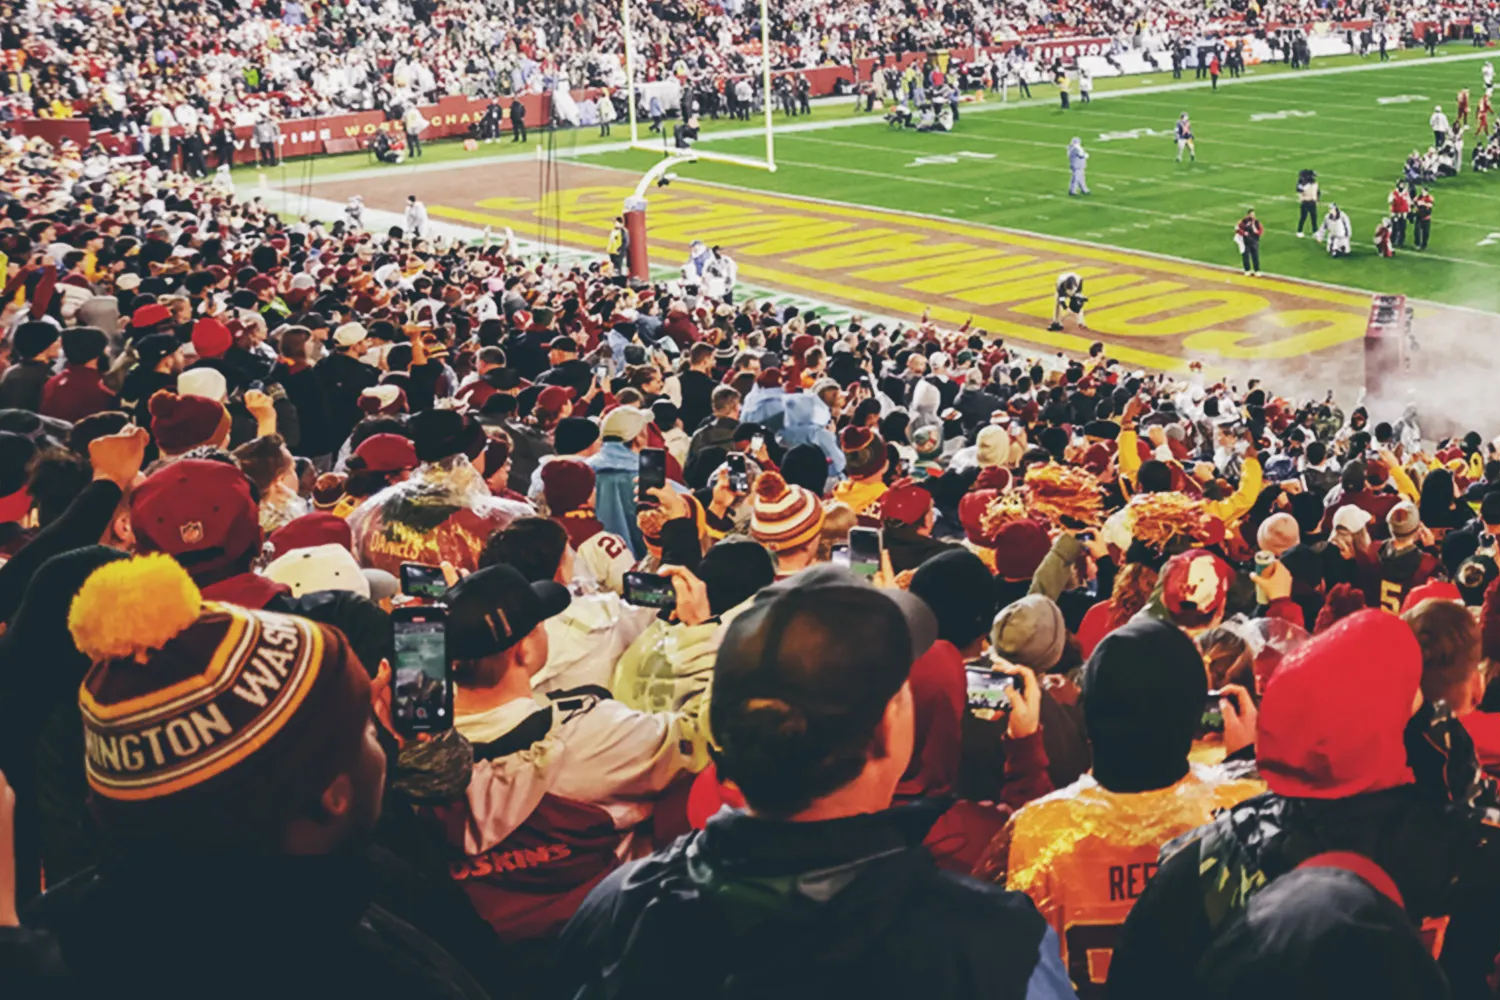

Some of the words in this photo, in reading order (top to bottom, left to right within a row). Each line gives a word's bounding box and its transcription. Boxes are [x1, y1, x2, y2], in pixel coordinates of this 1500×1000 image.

[344, 119, 404, 138] WORL
[1380, 579, 1402, 616] 5
[86, 702, 233, 772] INGTON
[451, 843, 572, 880] SKINS
